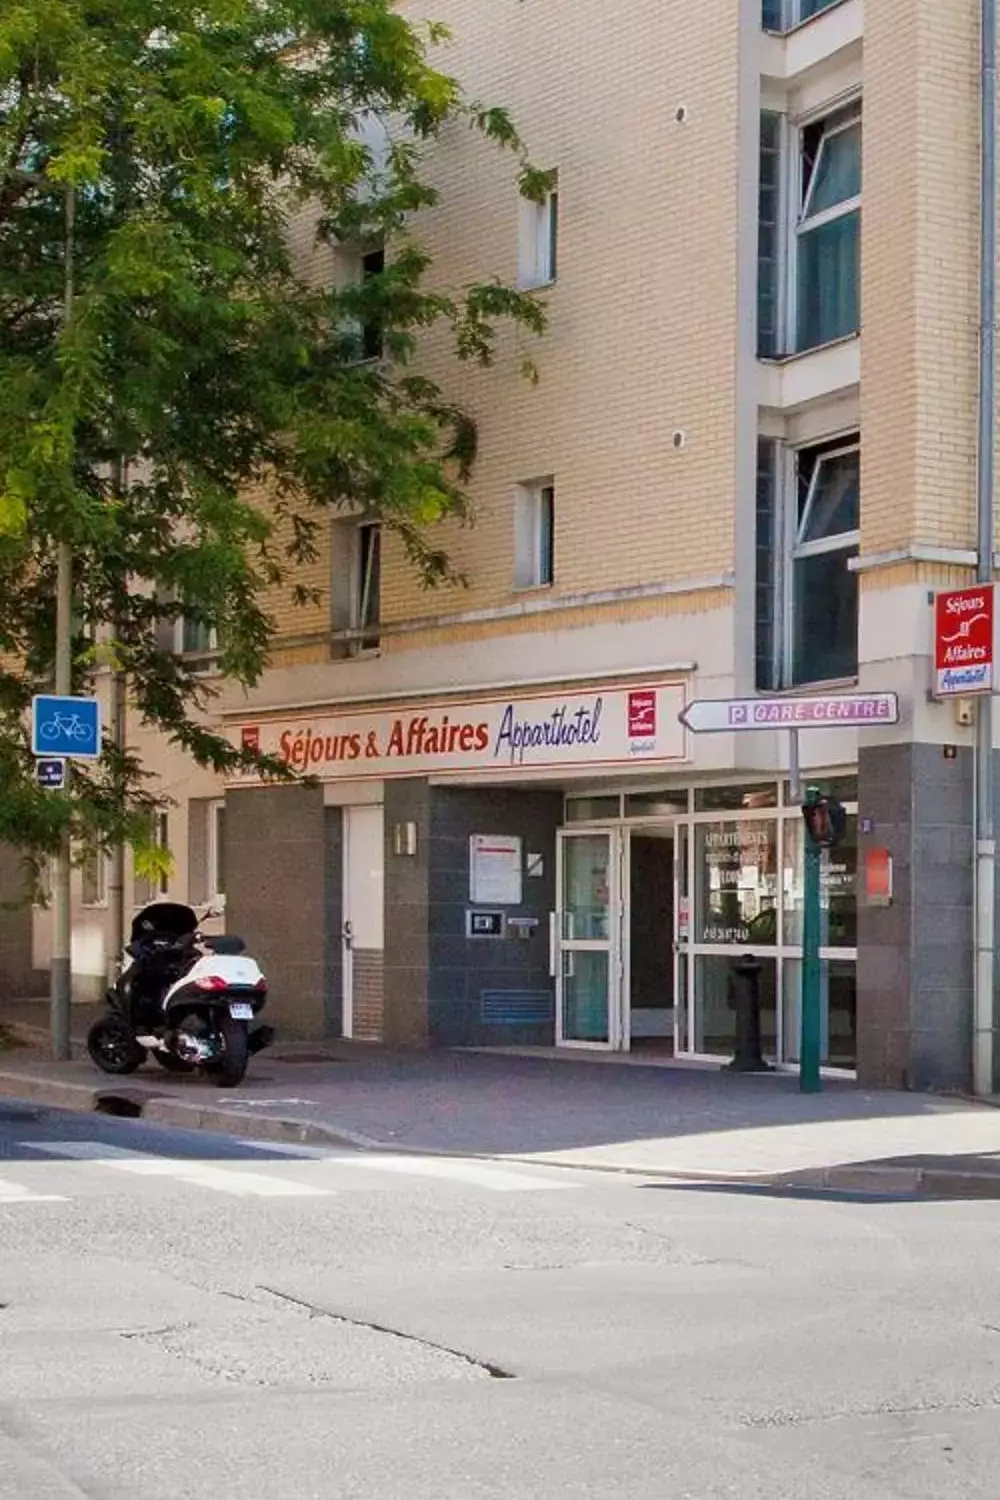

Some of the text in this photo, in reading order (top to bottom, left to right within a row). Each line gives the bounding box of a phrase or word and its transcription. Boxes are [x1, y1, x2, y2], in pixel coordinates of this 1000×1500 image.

[945, 596, 984, 615] Séjours
[944, 643, 986, 662] Affaires
[731, 700, 888, 723] P GARE CENTRE
[280, 696, 603, 772] Séjours & Affaires Apparthotel
